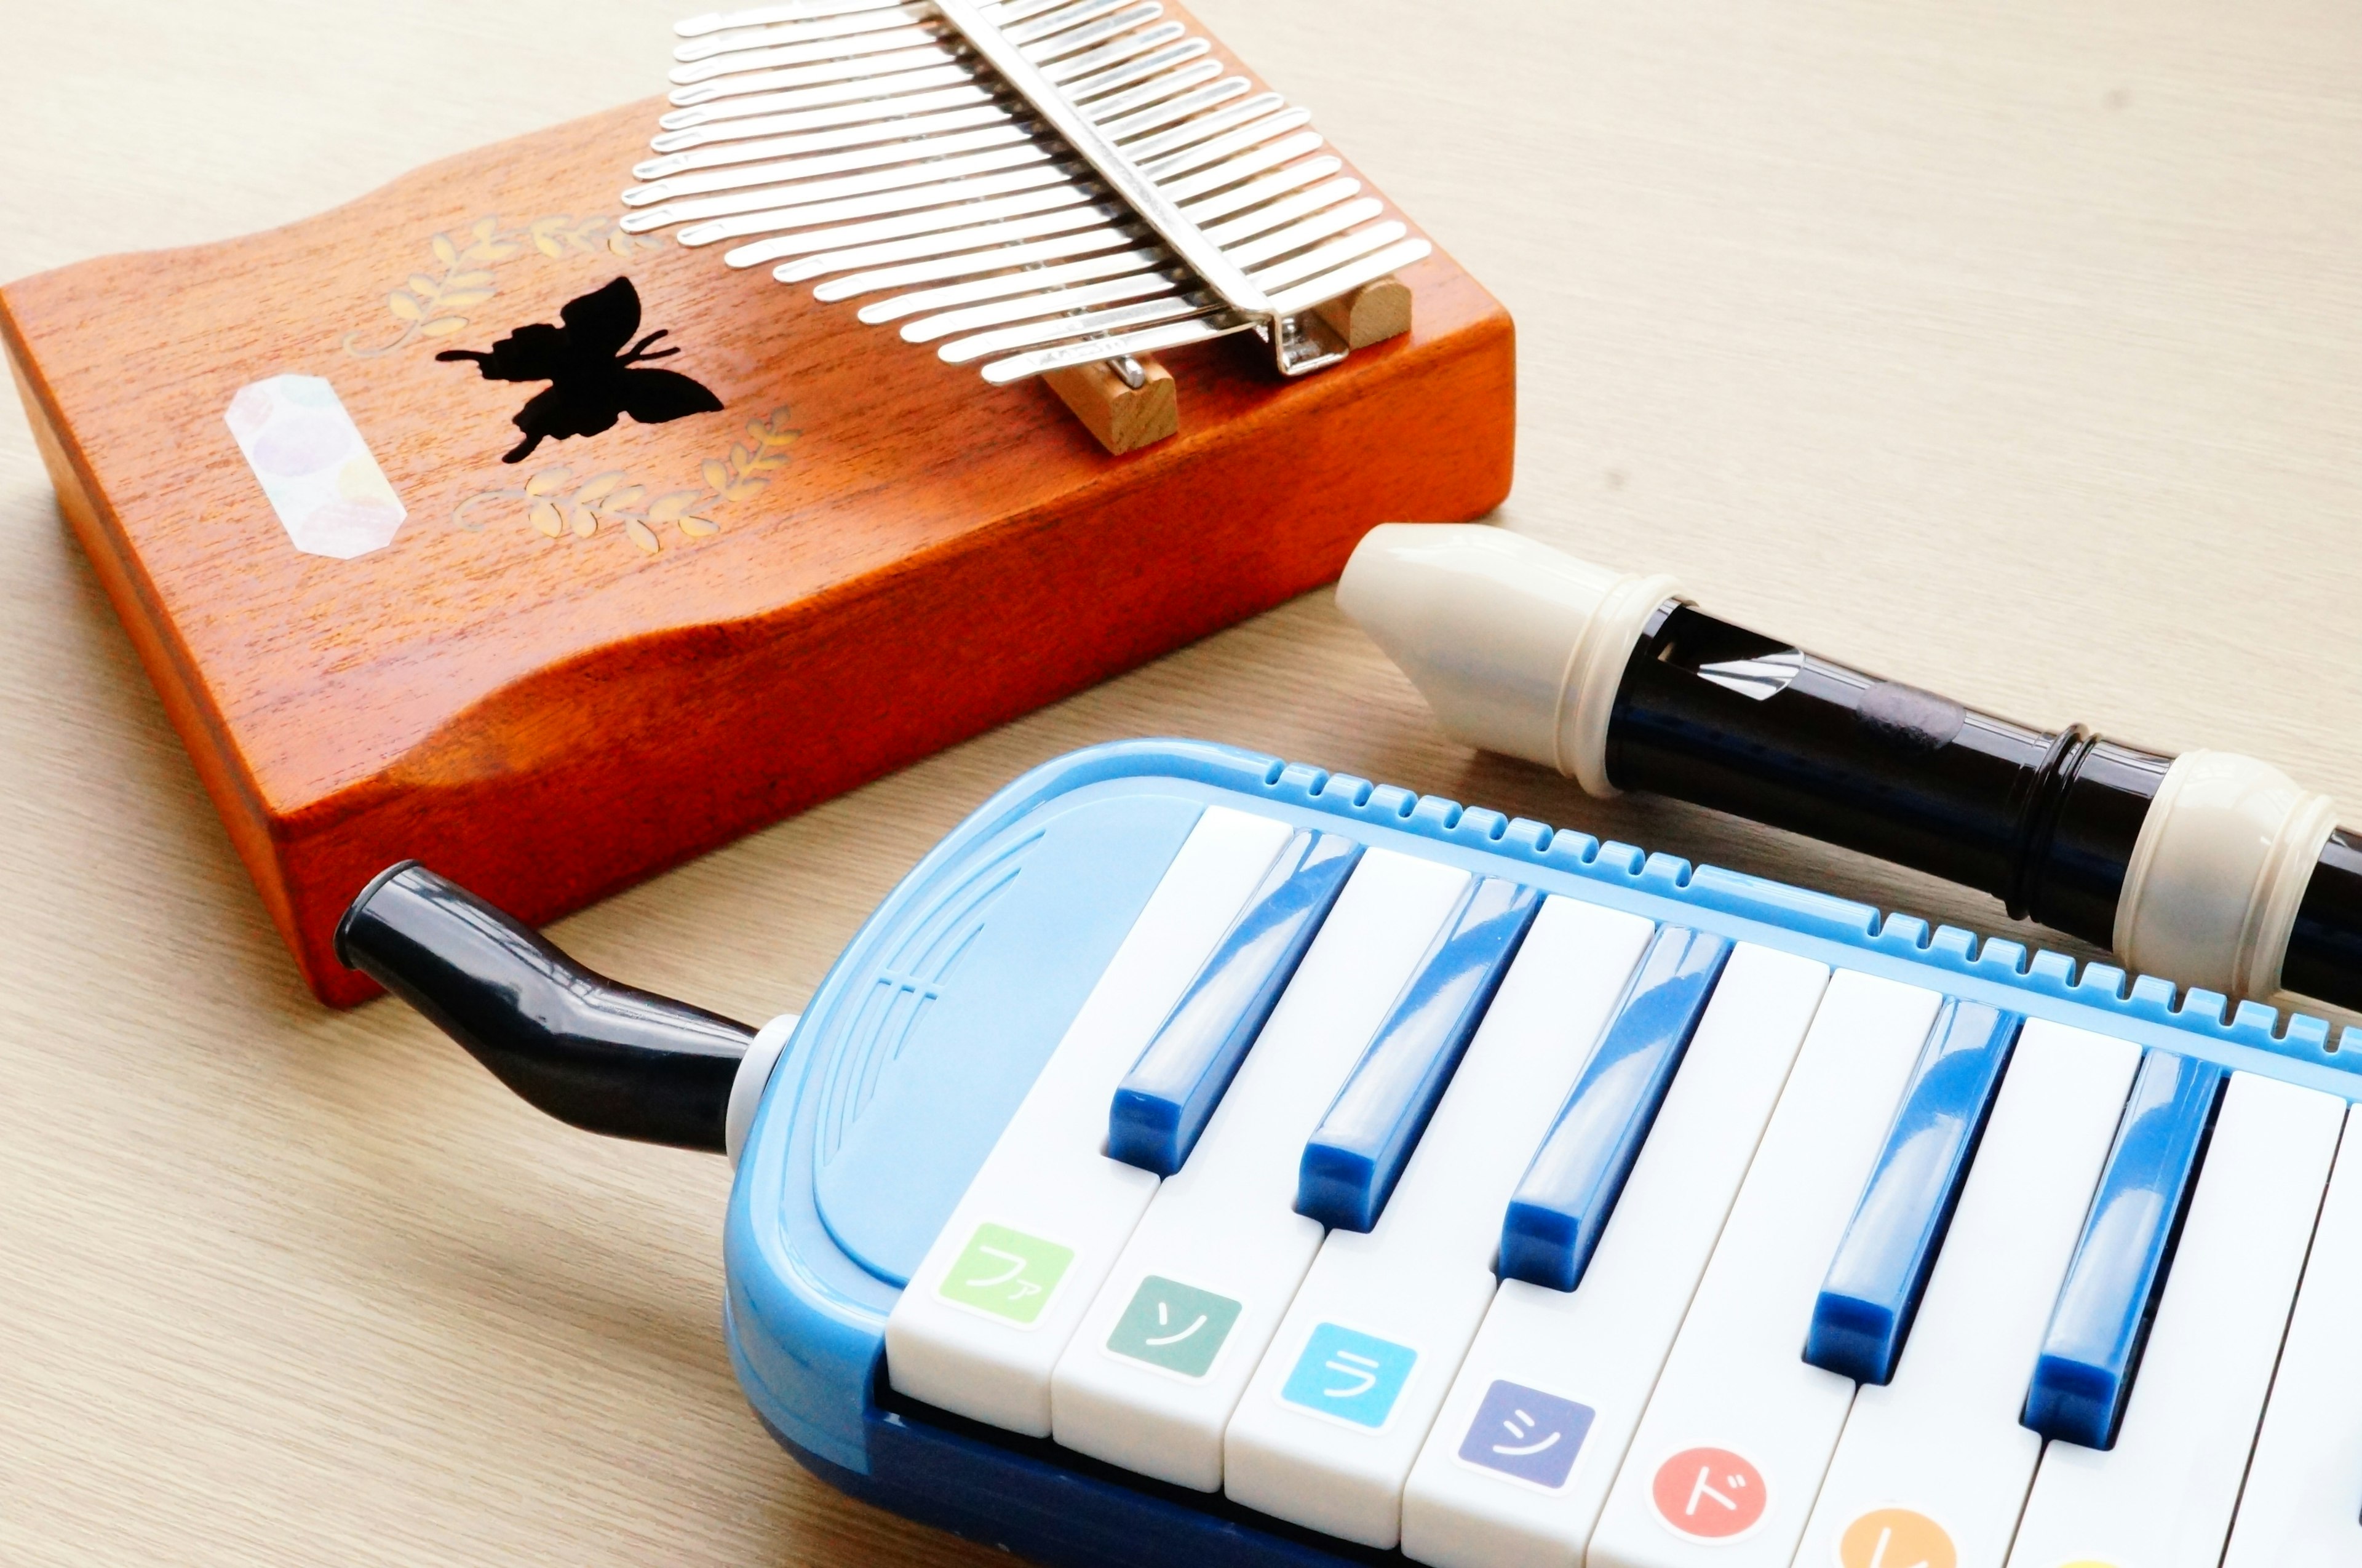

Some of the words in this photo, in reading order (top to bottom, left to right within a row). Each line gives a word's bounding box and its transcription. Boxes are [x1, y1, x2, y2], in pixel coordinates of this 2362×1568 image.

[964, 1245, 1042, 1300] ファ
[1145, 1301, 1207, 1345] ソ
[1324, 1350, 1380, 1398] ラ
[1492, 1409, 1561, 1455] シ
[1685, 1466, 1746, 1516] ド
